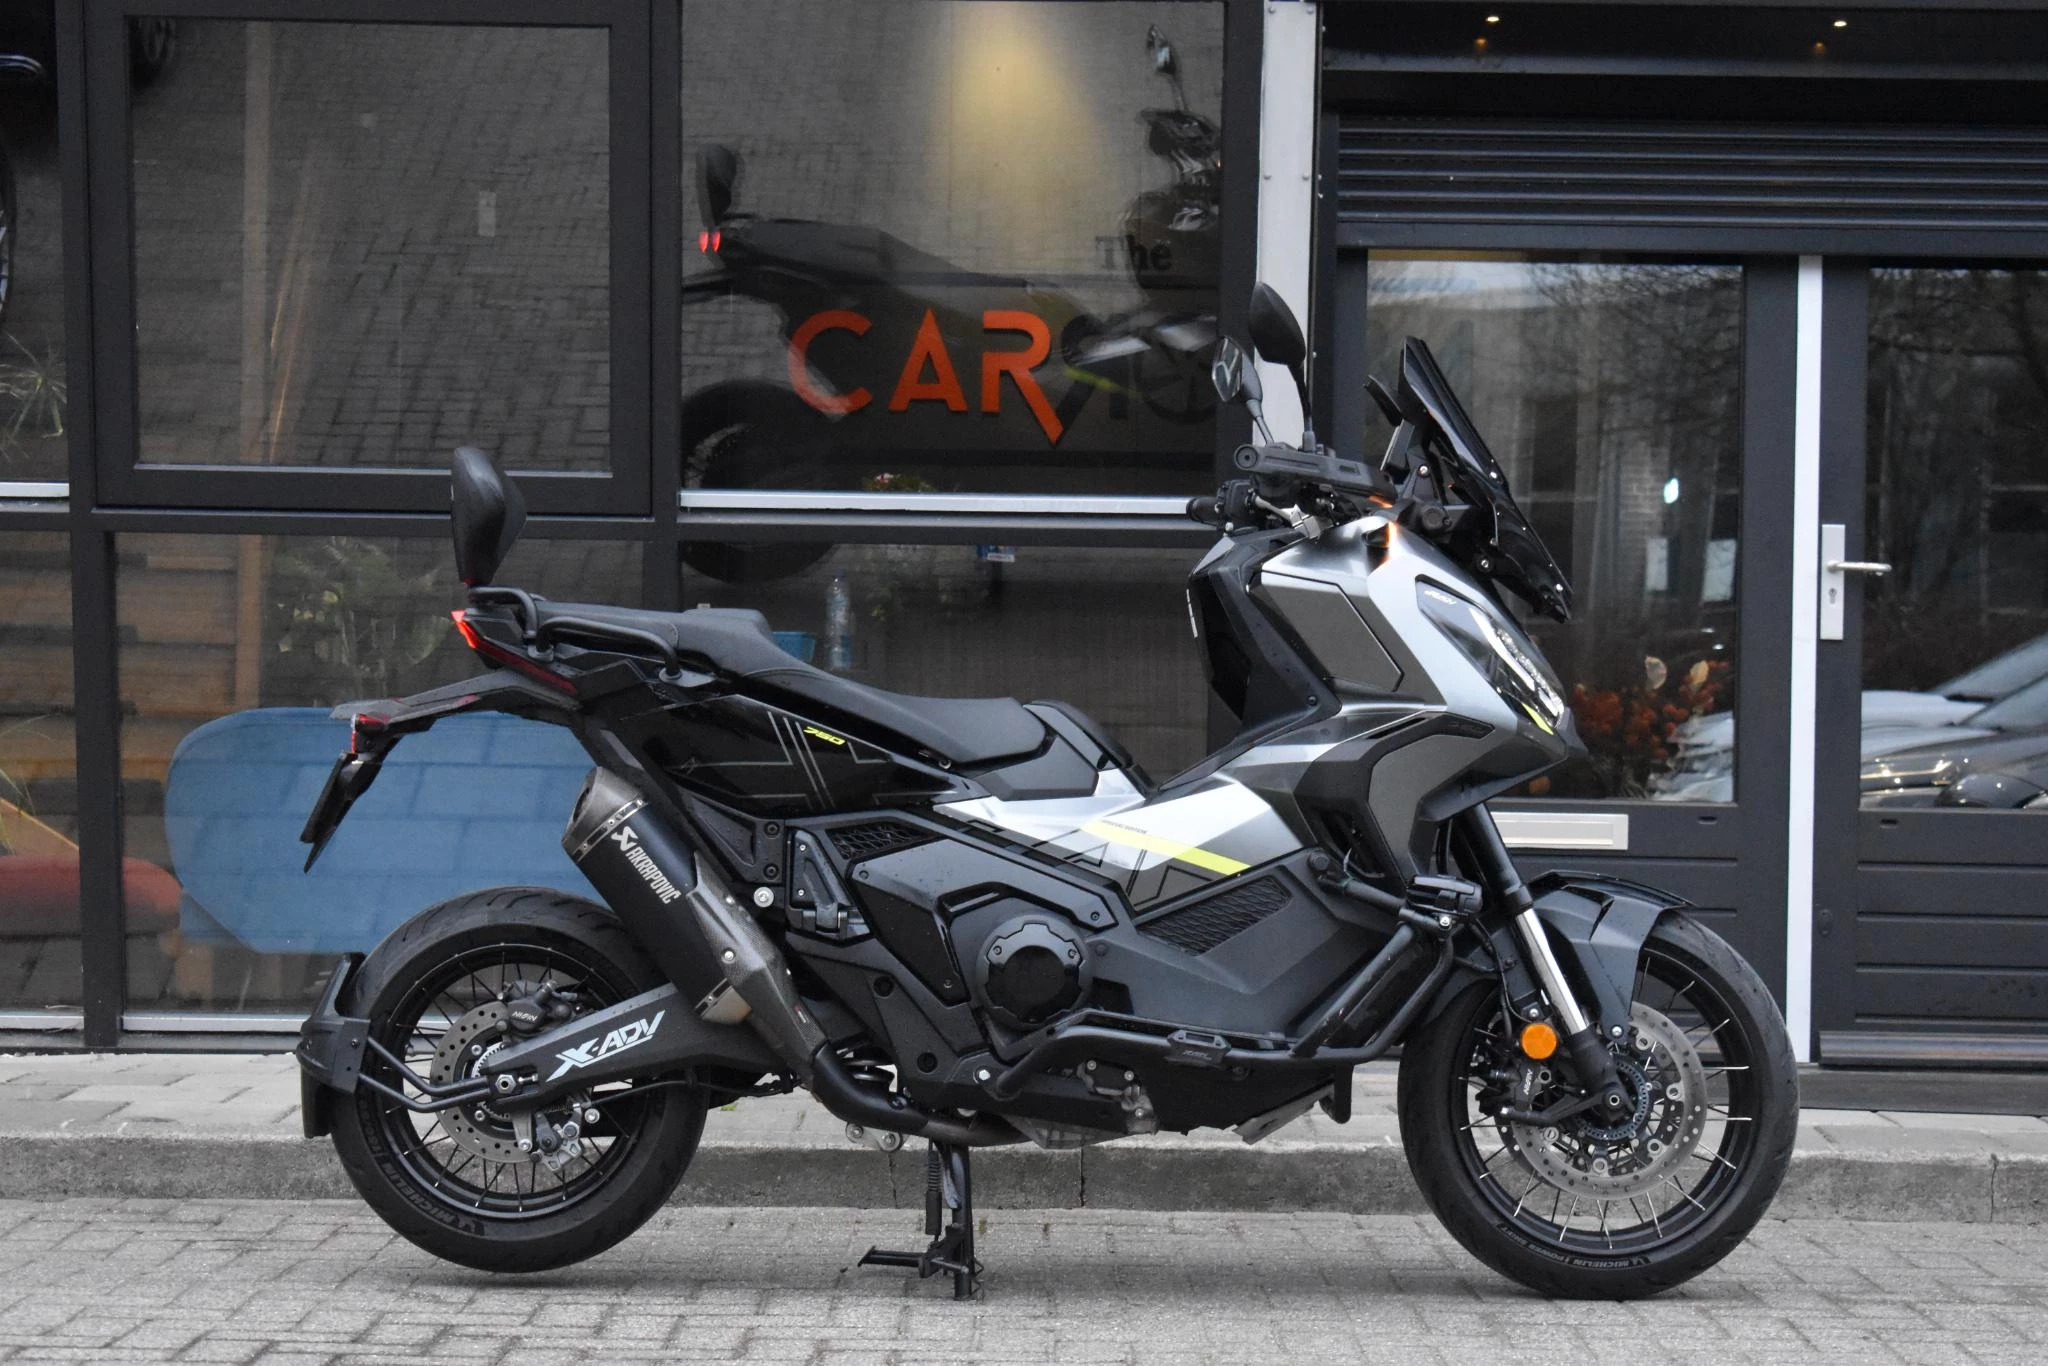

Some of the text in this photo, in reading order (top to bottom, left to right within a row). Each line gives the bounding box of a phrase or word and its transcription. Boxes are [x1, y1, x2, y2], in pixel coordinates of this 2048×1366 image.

[1095, 234, 1172, 272] The
[803, 726, 846, 745] 750
[545, 1010, 665, 1082] X-ADV
[381, 1161, 456, 1222] MICHELIN
[1574, 1258, 1630, 1269] MICHELIN
